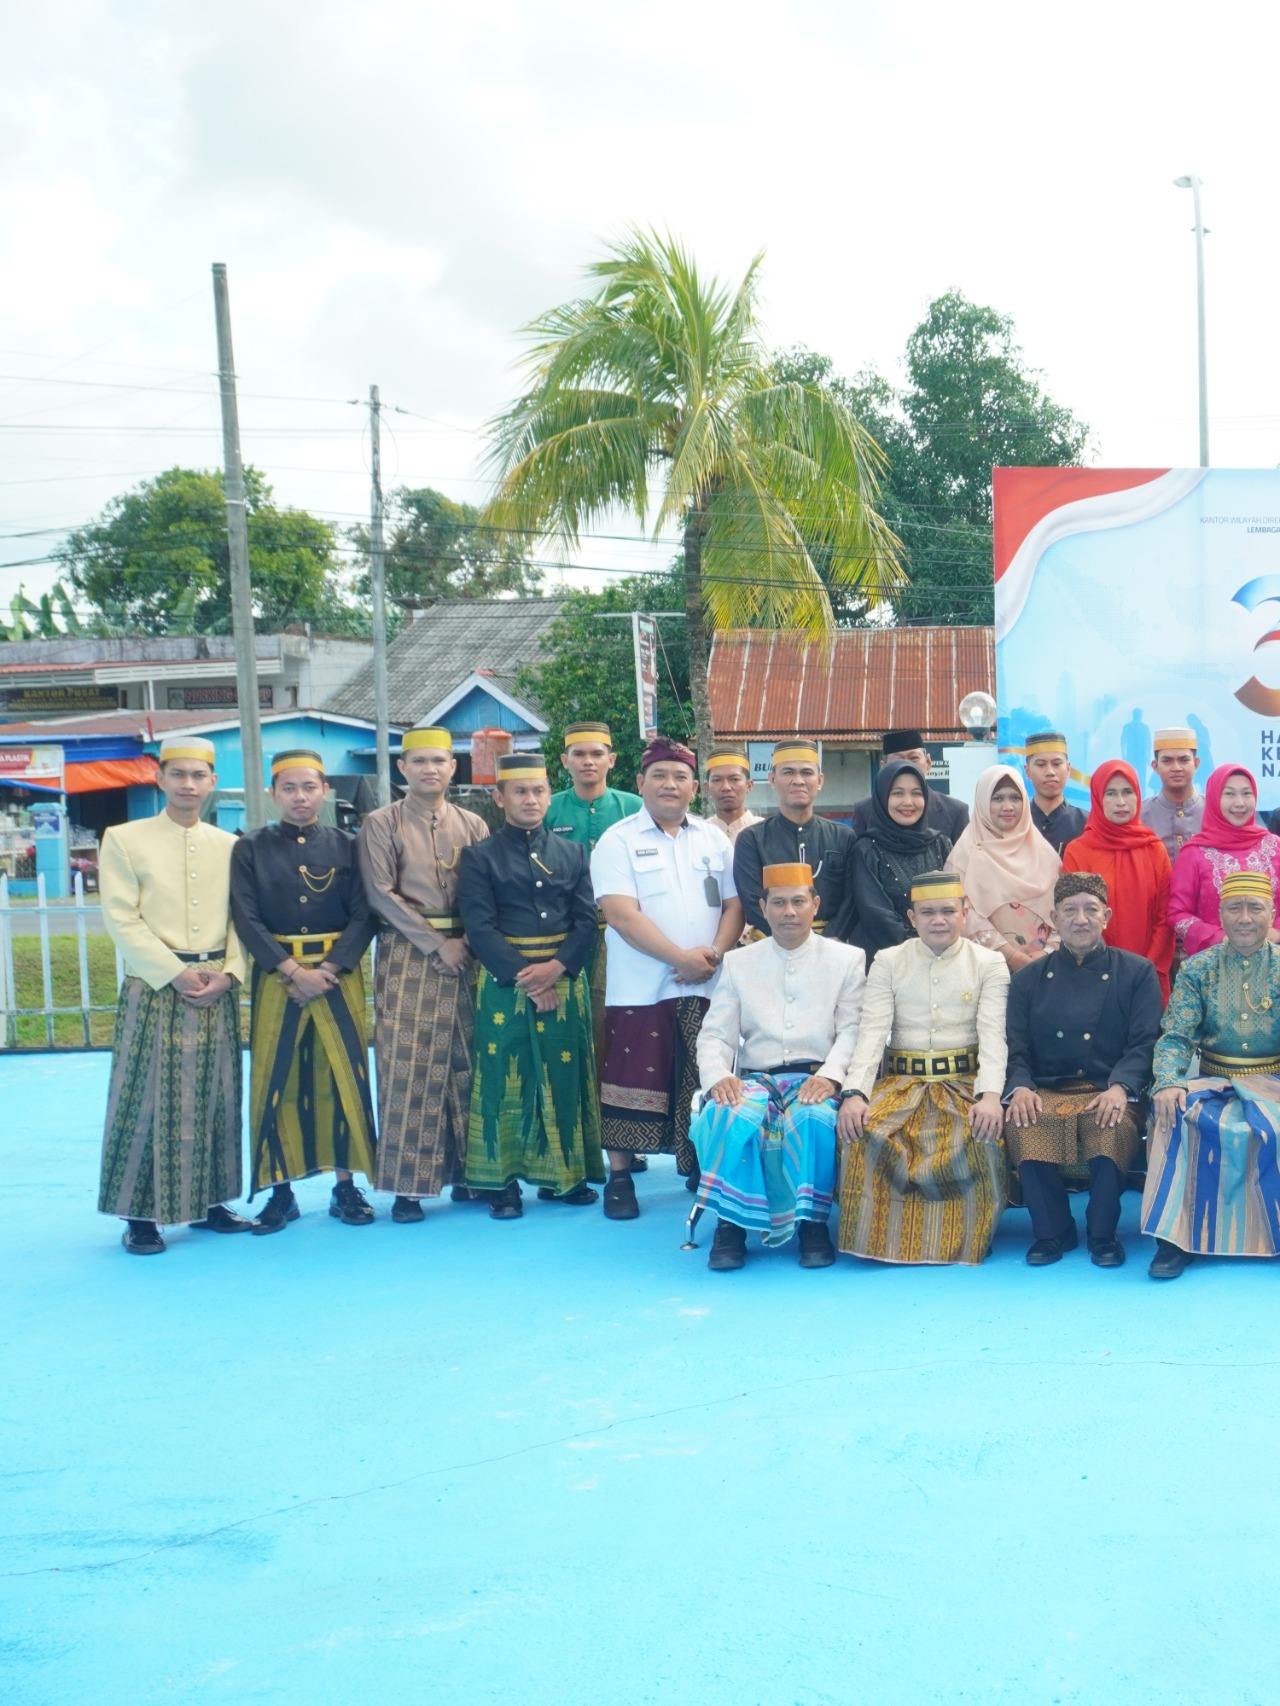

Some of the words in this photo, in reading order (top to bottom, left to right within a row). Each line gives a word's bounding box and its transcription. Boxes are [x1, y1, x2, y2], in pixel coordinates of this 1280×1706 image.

[1200, 516, 1228, 524] KANTOR
[1229, 516, 1261, 524] WILAYAH
[1247, 526, 1280, 534] LEMBAGA
